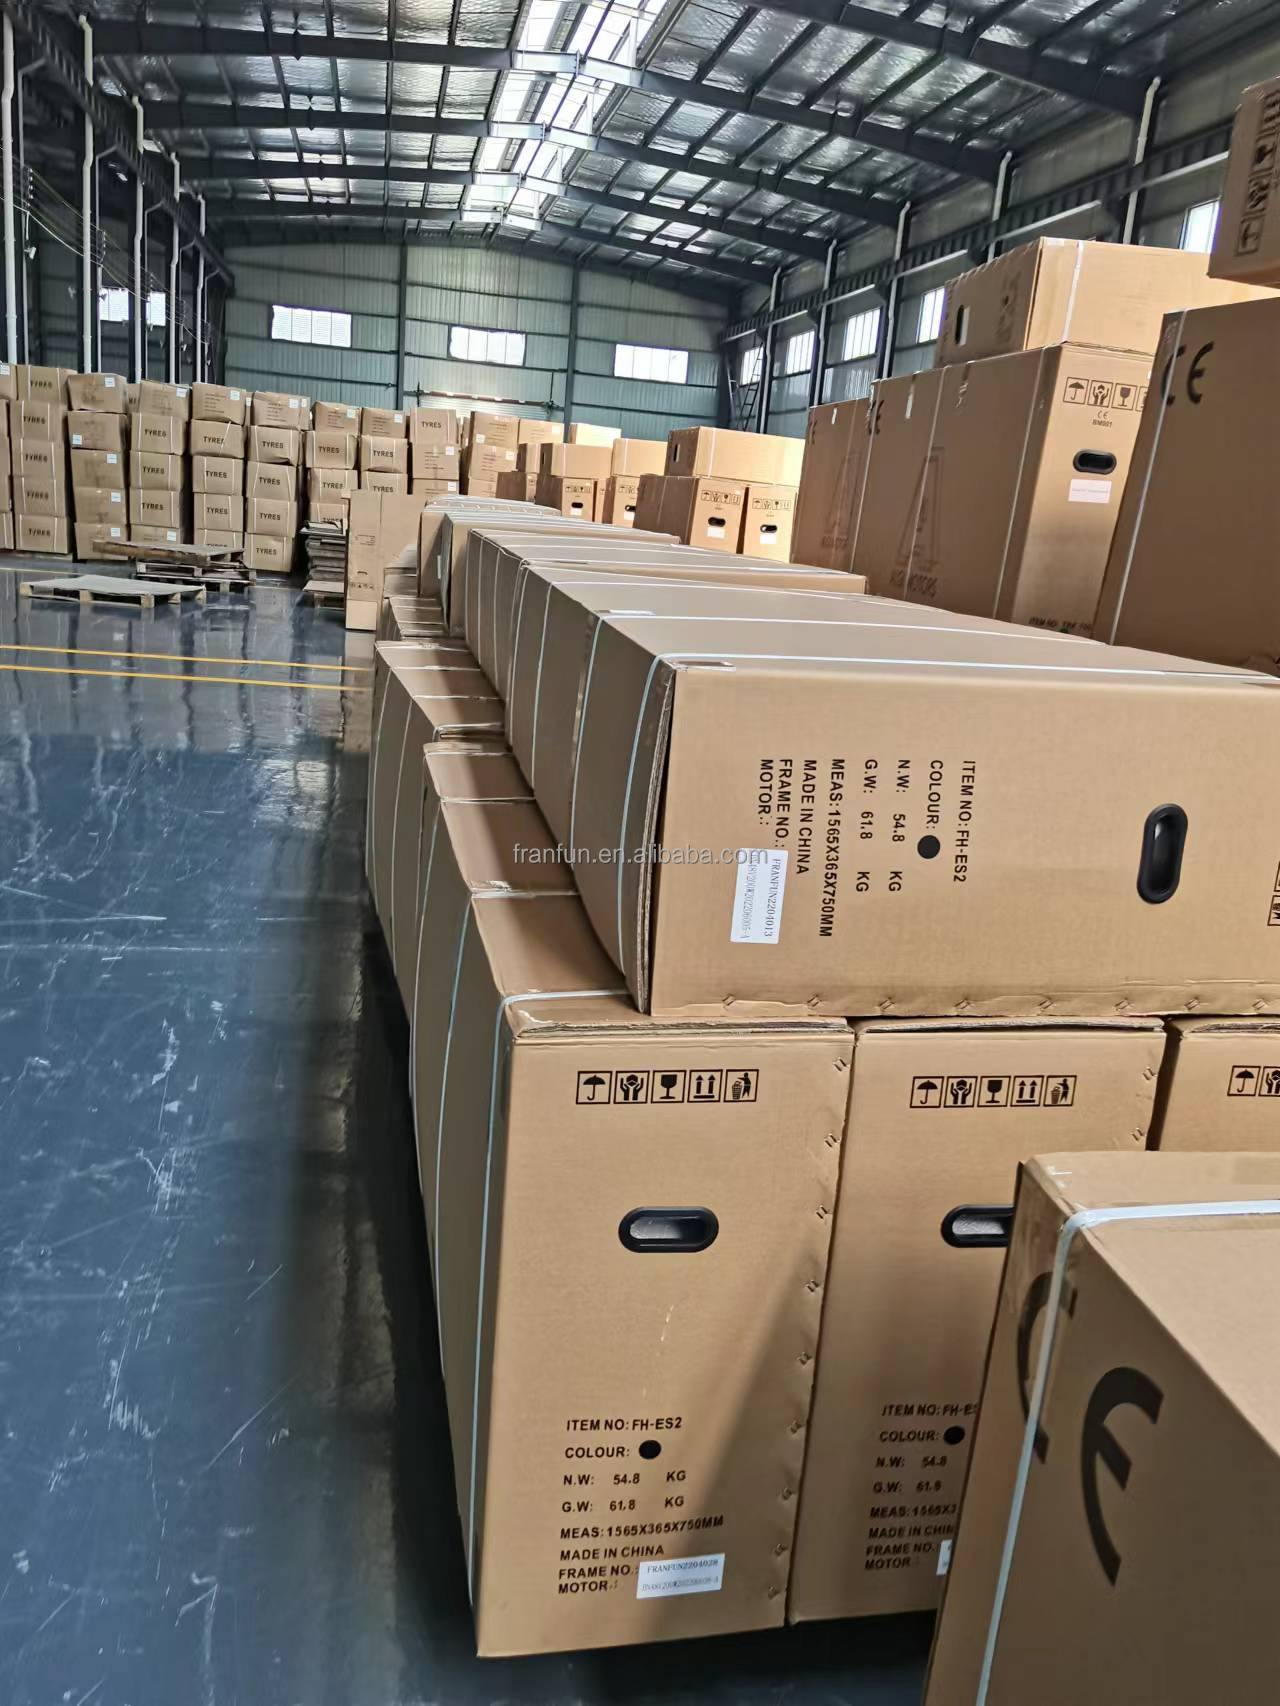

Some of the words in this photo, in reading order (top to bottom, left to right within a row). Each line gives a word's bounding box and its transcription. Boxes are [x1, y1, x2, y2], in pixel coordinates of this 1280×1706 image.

[30, 379, 53, 390] TYRES
[23, 415, 46, 425] TYRES
[144, 428, 167, 438] TYRES
[262, 440, 284, 449] TYRES
[318, 446, 340, 454] TYRES
[25, 453, 48, 463] TYRES
[373, 450, 394, 458] TYRES
[142, 465, 165, 475] TYRES
[206, 470, 228, 479] TYRES
[259, 476, 281, 486] TYRES
[27, 490, 49, 500] TYRES
[142, 502, 164, 511] TYRES
[206, 506, 228, 516] TYRES
[259, 512, 281, 521] TYRES
[28, 528, 51, 537] TYRES
[256, 547, 277, 556] TYRES
[801, 759, 817, 804] MADE
[863, 759, 878, 794] G.W:
[896, 759, 911, 793] N.W:
[960, 760, 976, 796] ITEM
[776, 758, 793, 813] FRAME
[925, 759, 944, 830] COLOUR:
[799, 808, 814, 823] IN
[859, 811, 874, 840] 61.8
[892, 813, 906, 843] 54.8
[796, 826, 813, 875] CHINA
[953, 829, 970, 883] FH-ES2
[819, 810, 841, 937] 1565X365X750MM
[855, 871, 870, 892] KG
[888, 871, 903, 892] KG
[881, 1403, 915, 1416] ITEM
[566, 1419, 601, 1432] ITEM
[632, 1416, 683, 1431] FH-ES2
[879, 1430, 941, 1442] COLOUR:
[564, 1446, 630, 1459] COLOUR:
[563, 1474, 595, 1486] N.W:
[613, 1473, 640, 1485] 54.8
[666, 1470, 686, 1482] KG
[562, 1501, 593, 1514] G.W:
[609, 1500, 636, 1512] 61.8
[664, 1496, 684, 1508] KG
[607, 1514, 725, 1537] 1565X365X750MM
[868, 1527, 906, 1538] MADE
[908, 1525, 921, 1536] IN
[560, 1549, 600, 1561] MADE
[604, 1548, 618, 1560] IN
[620, 1545, 664, 1558] CHINA
[866, 1542, 910, 1556] FRAME
[558, 1566, 606, 1580] FRAME
